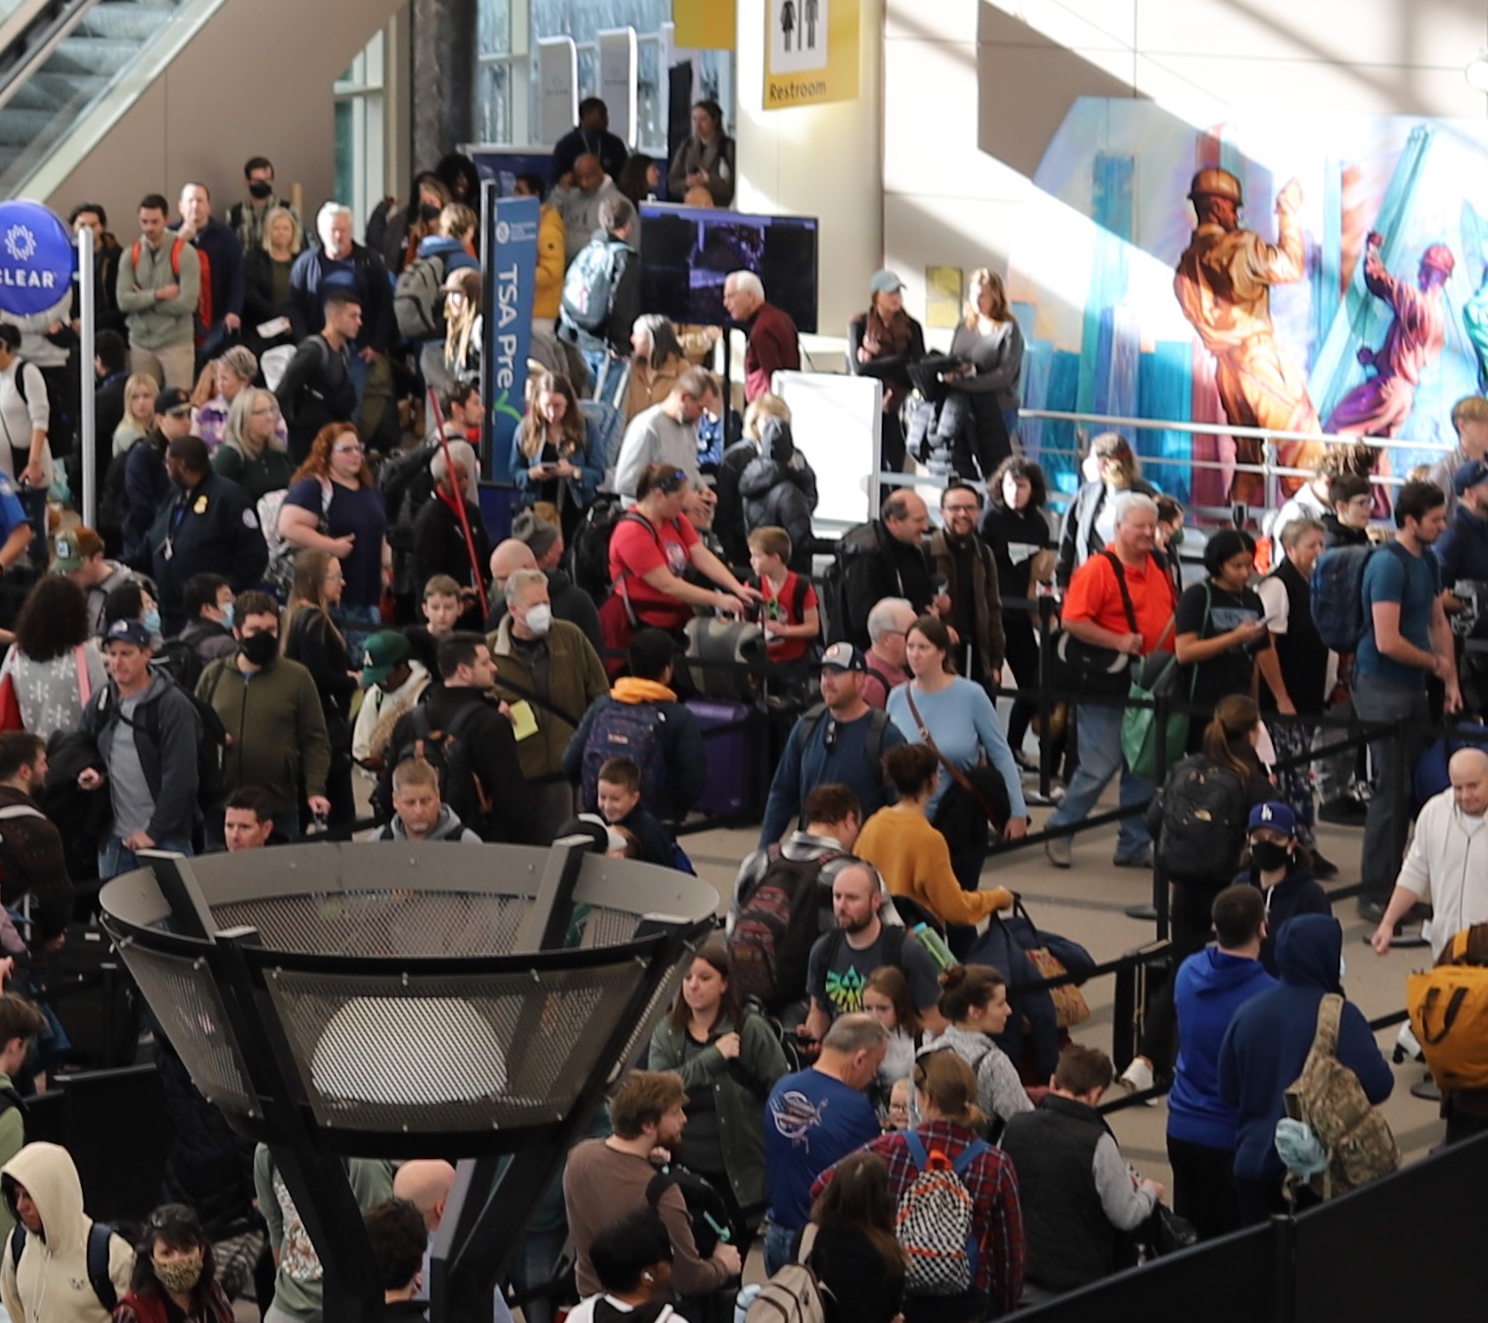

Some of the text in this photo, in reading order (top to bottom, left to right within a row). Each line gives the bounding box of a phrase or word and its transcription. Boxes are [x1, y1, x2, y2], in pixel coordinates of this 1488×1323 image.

[769, 80, 827, 102] Restroom
[497, 263, 519, 389] TSA Pre
